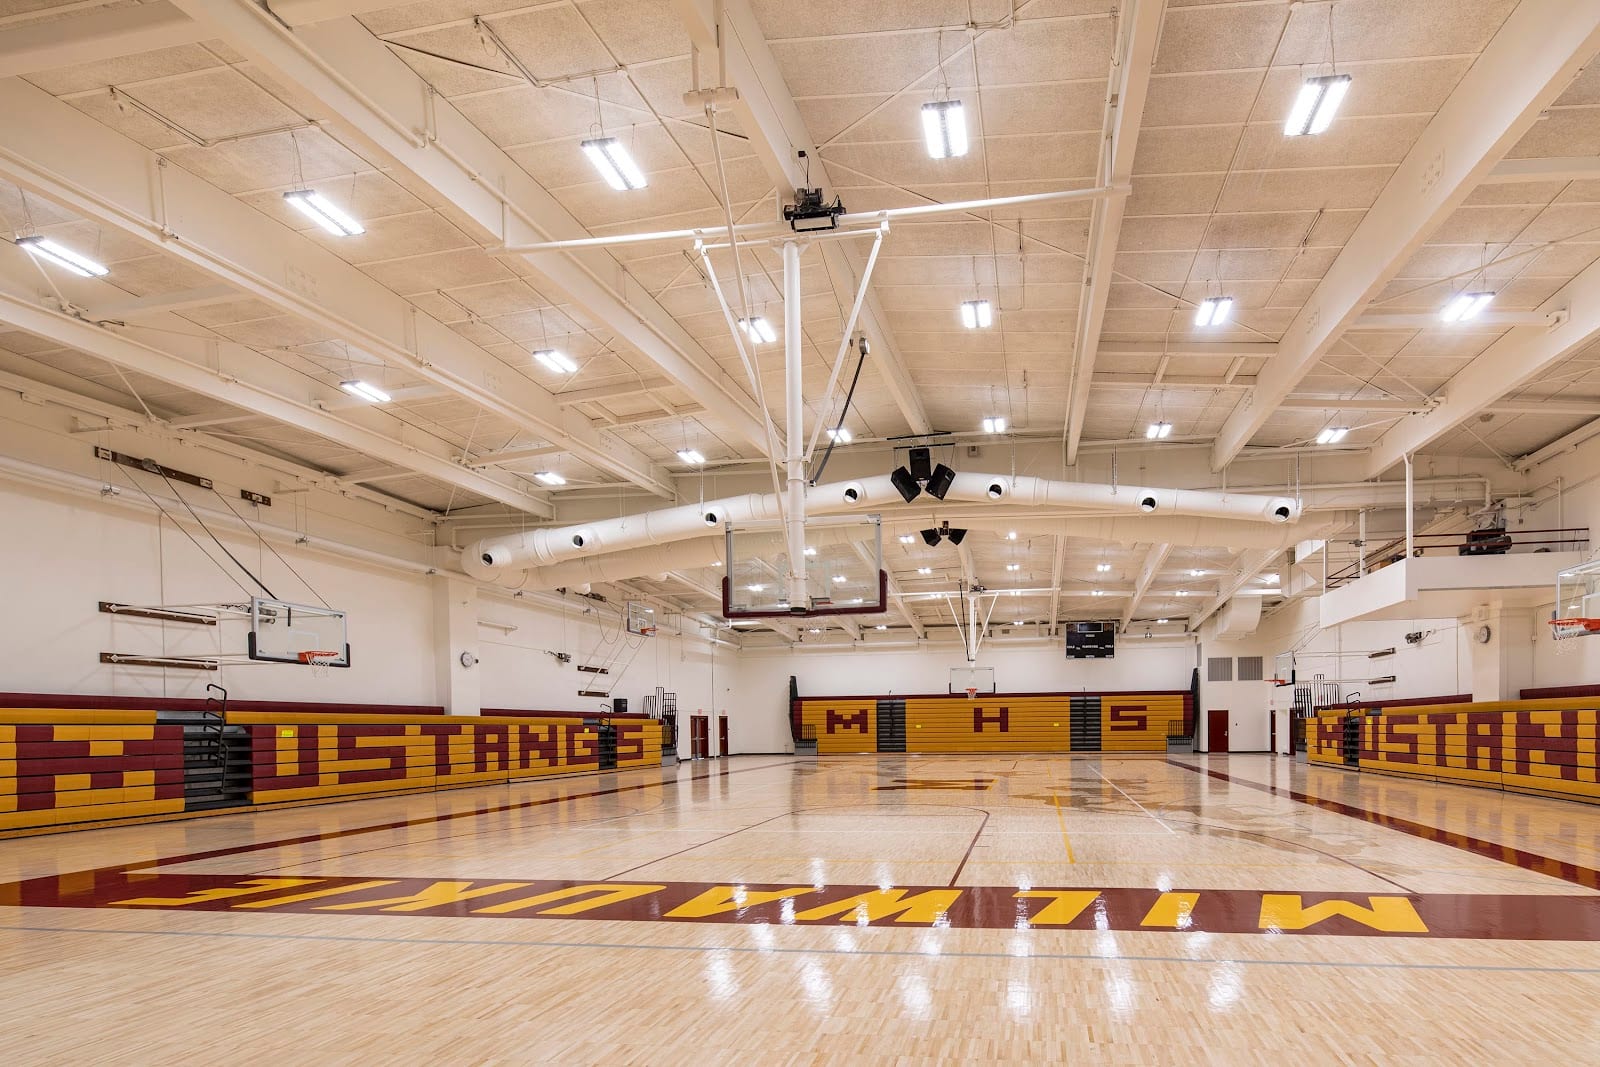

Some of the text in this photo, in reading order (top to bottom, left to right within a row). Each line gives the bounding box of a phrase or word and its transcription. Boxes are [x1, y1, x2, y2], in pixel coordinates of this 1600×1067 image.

[826, 705, 1147, 734] M H S
[1317, 710, 1600, 783] MUSTAN
[16, 724, 642, 809] MUSTANGS
[107, 879, 1429, 932] MILWAUKIE
